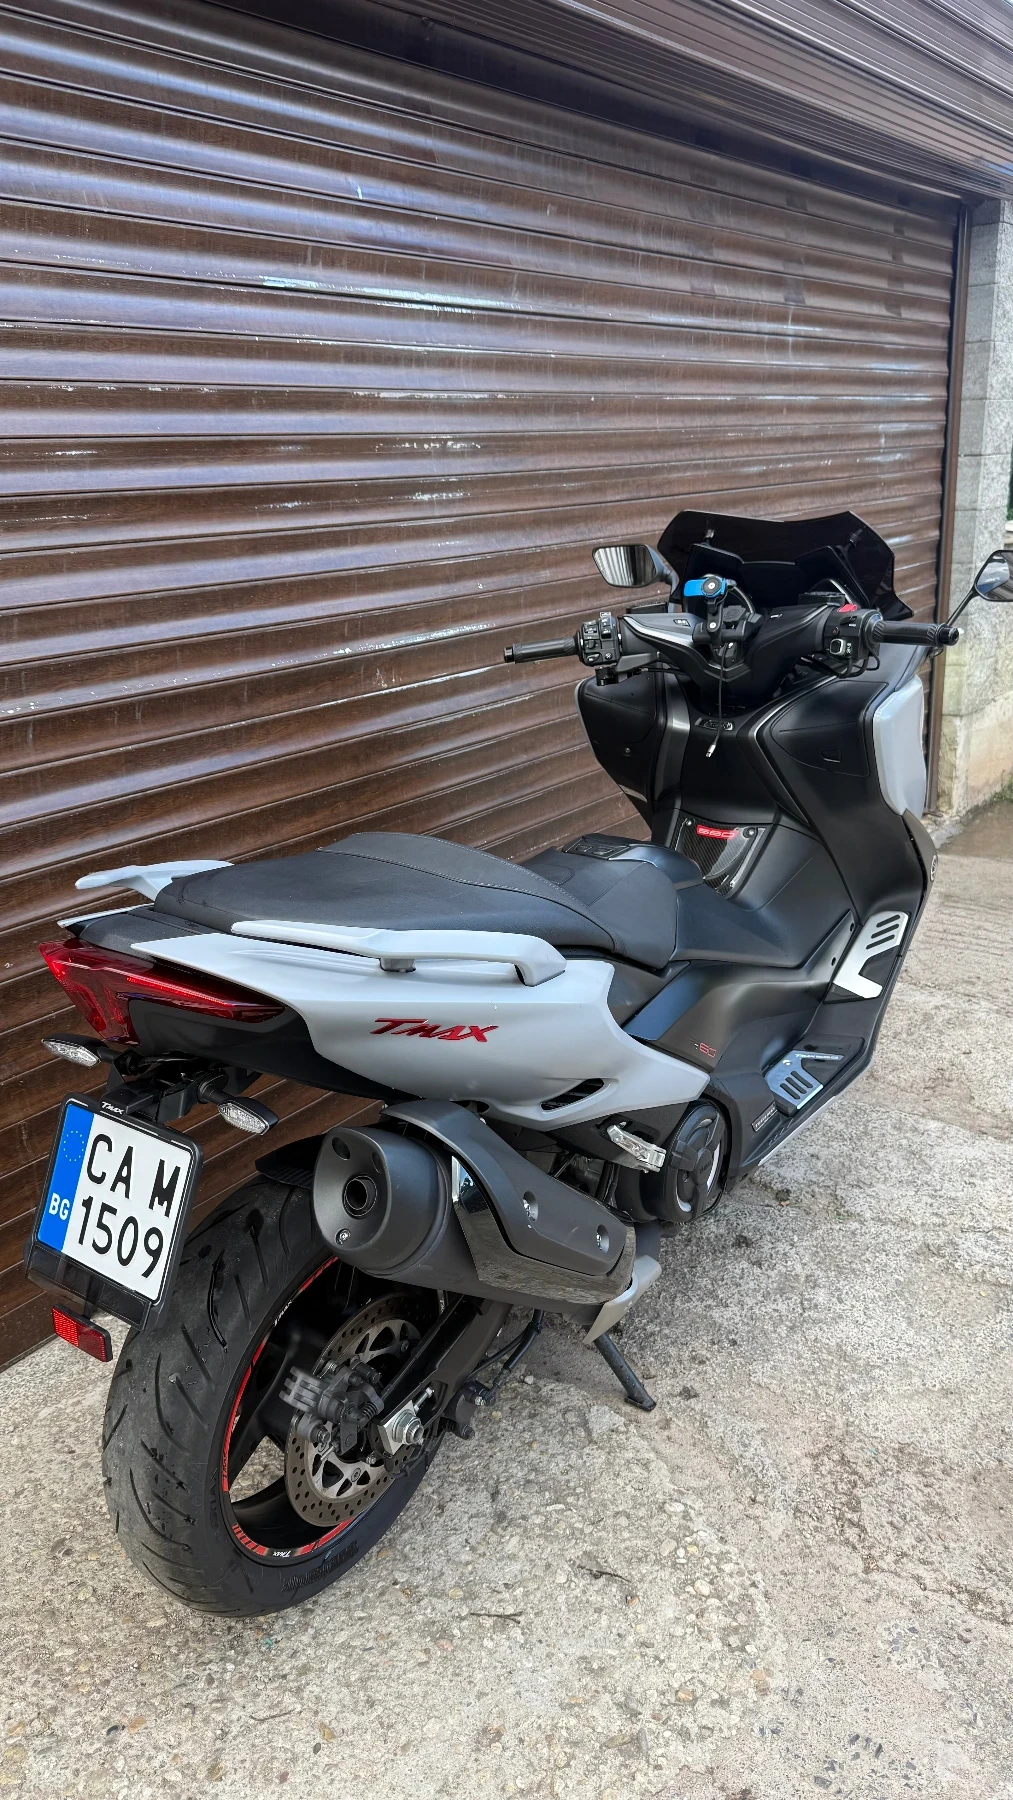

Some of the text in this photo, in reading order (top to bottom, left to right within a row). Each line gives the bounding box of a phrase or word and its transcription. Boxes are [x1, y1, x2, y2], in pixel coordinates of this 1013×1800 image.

[370, 1017, 499, 1042] TMAX
[101, 1101, 124, 1115] TMAX
[86, 1133, 181, 1218] CA M
[49, 1193, 71, 1220] BG
[78, 1195, 164, 1279] 1509
